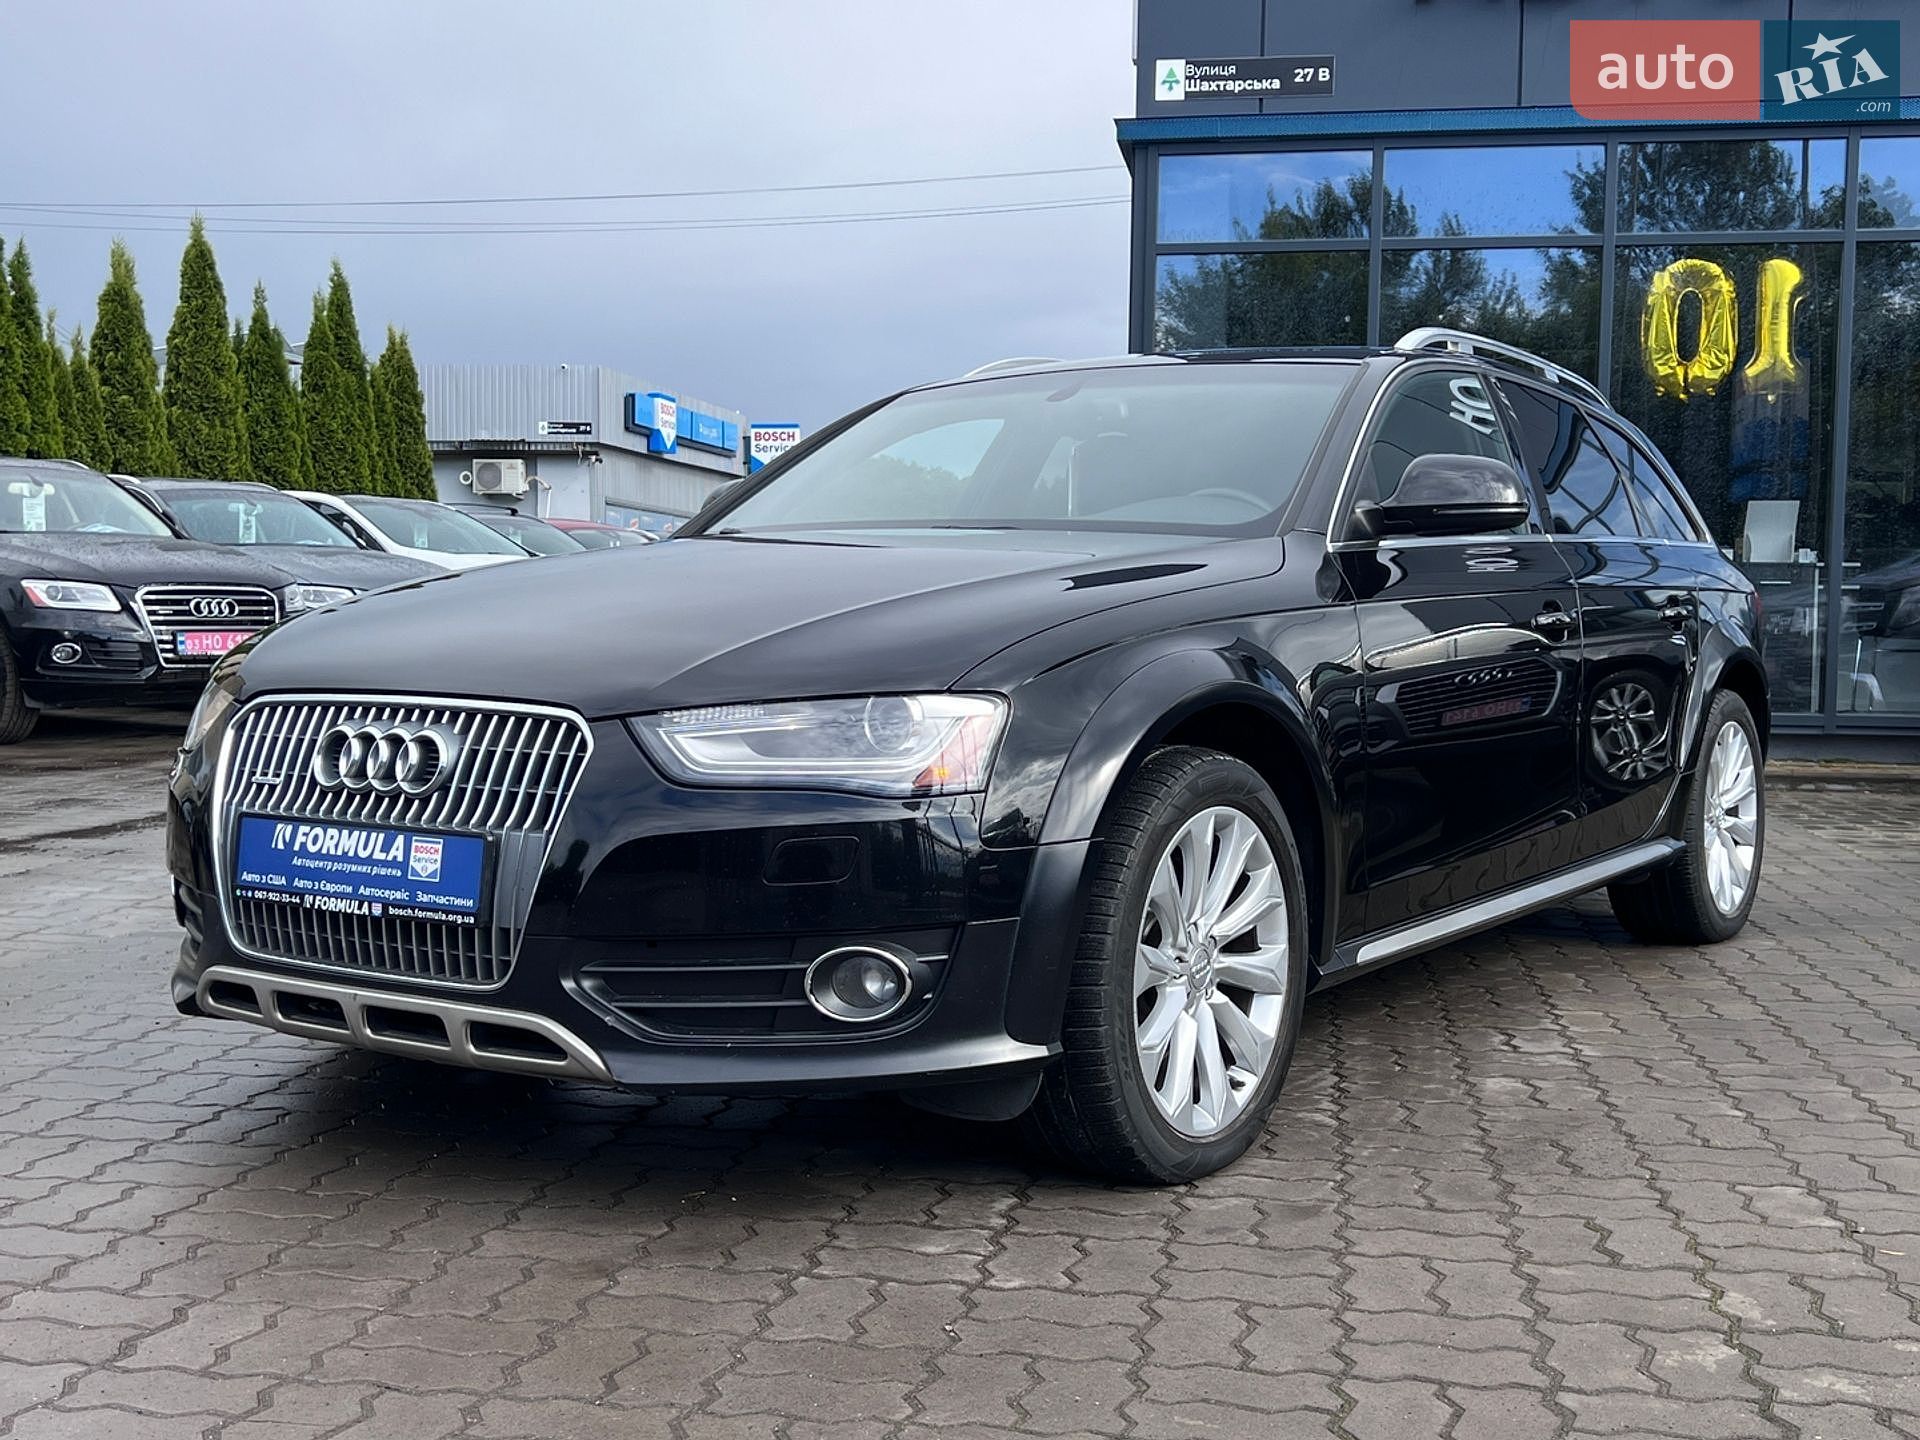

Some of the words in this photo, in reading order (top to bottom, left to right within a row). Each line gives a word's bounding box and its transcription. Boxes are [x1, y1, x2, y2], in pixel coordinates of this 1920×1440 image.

[1185, 64, 1236, 78] Вулиця
[1185, 78, 1281, 94] Шахтарська
[1293, 68, 1314, 82] 27
[754, 431, 796, 442] BOSCH
[754, 443, 792, 453] Servic
[293, 825, 405, 862] FORMULA
[413, 844, 440, 855] BOSCH
[291, 855, 332, 871] Автоцентр
[371, 864, 402, 878] рішень
[412, 855, 439, 865] Service
[241, 871, 261, 882] Авто
[266, 874, 287, 886] США
[293, 877, 313, 889] Авто
[320, 880, 353, 894] Європи
[358, 884, 410, 901] Автосервіс
[415, 890, 474, 908] Запчастини
[314, 896, 370, 916] FORMULA
[388, 905, 475, 925] bosch.formula.org.ua
